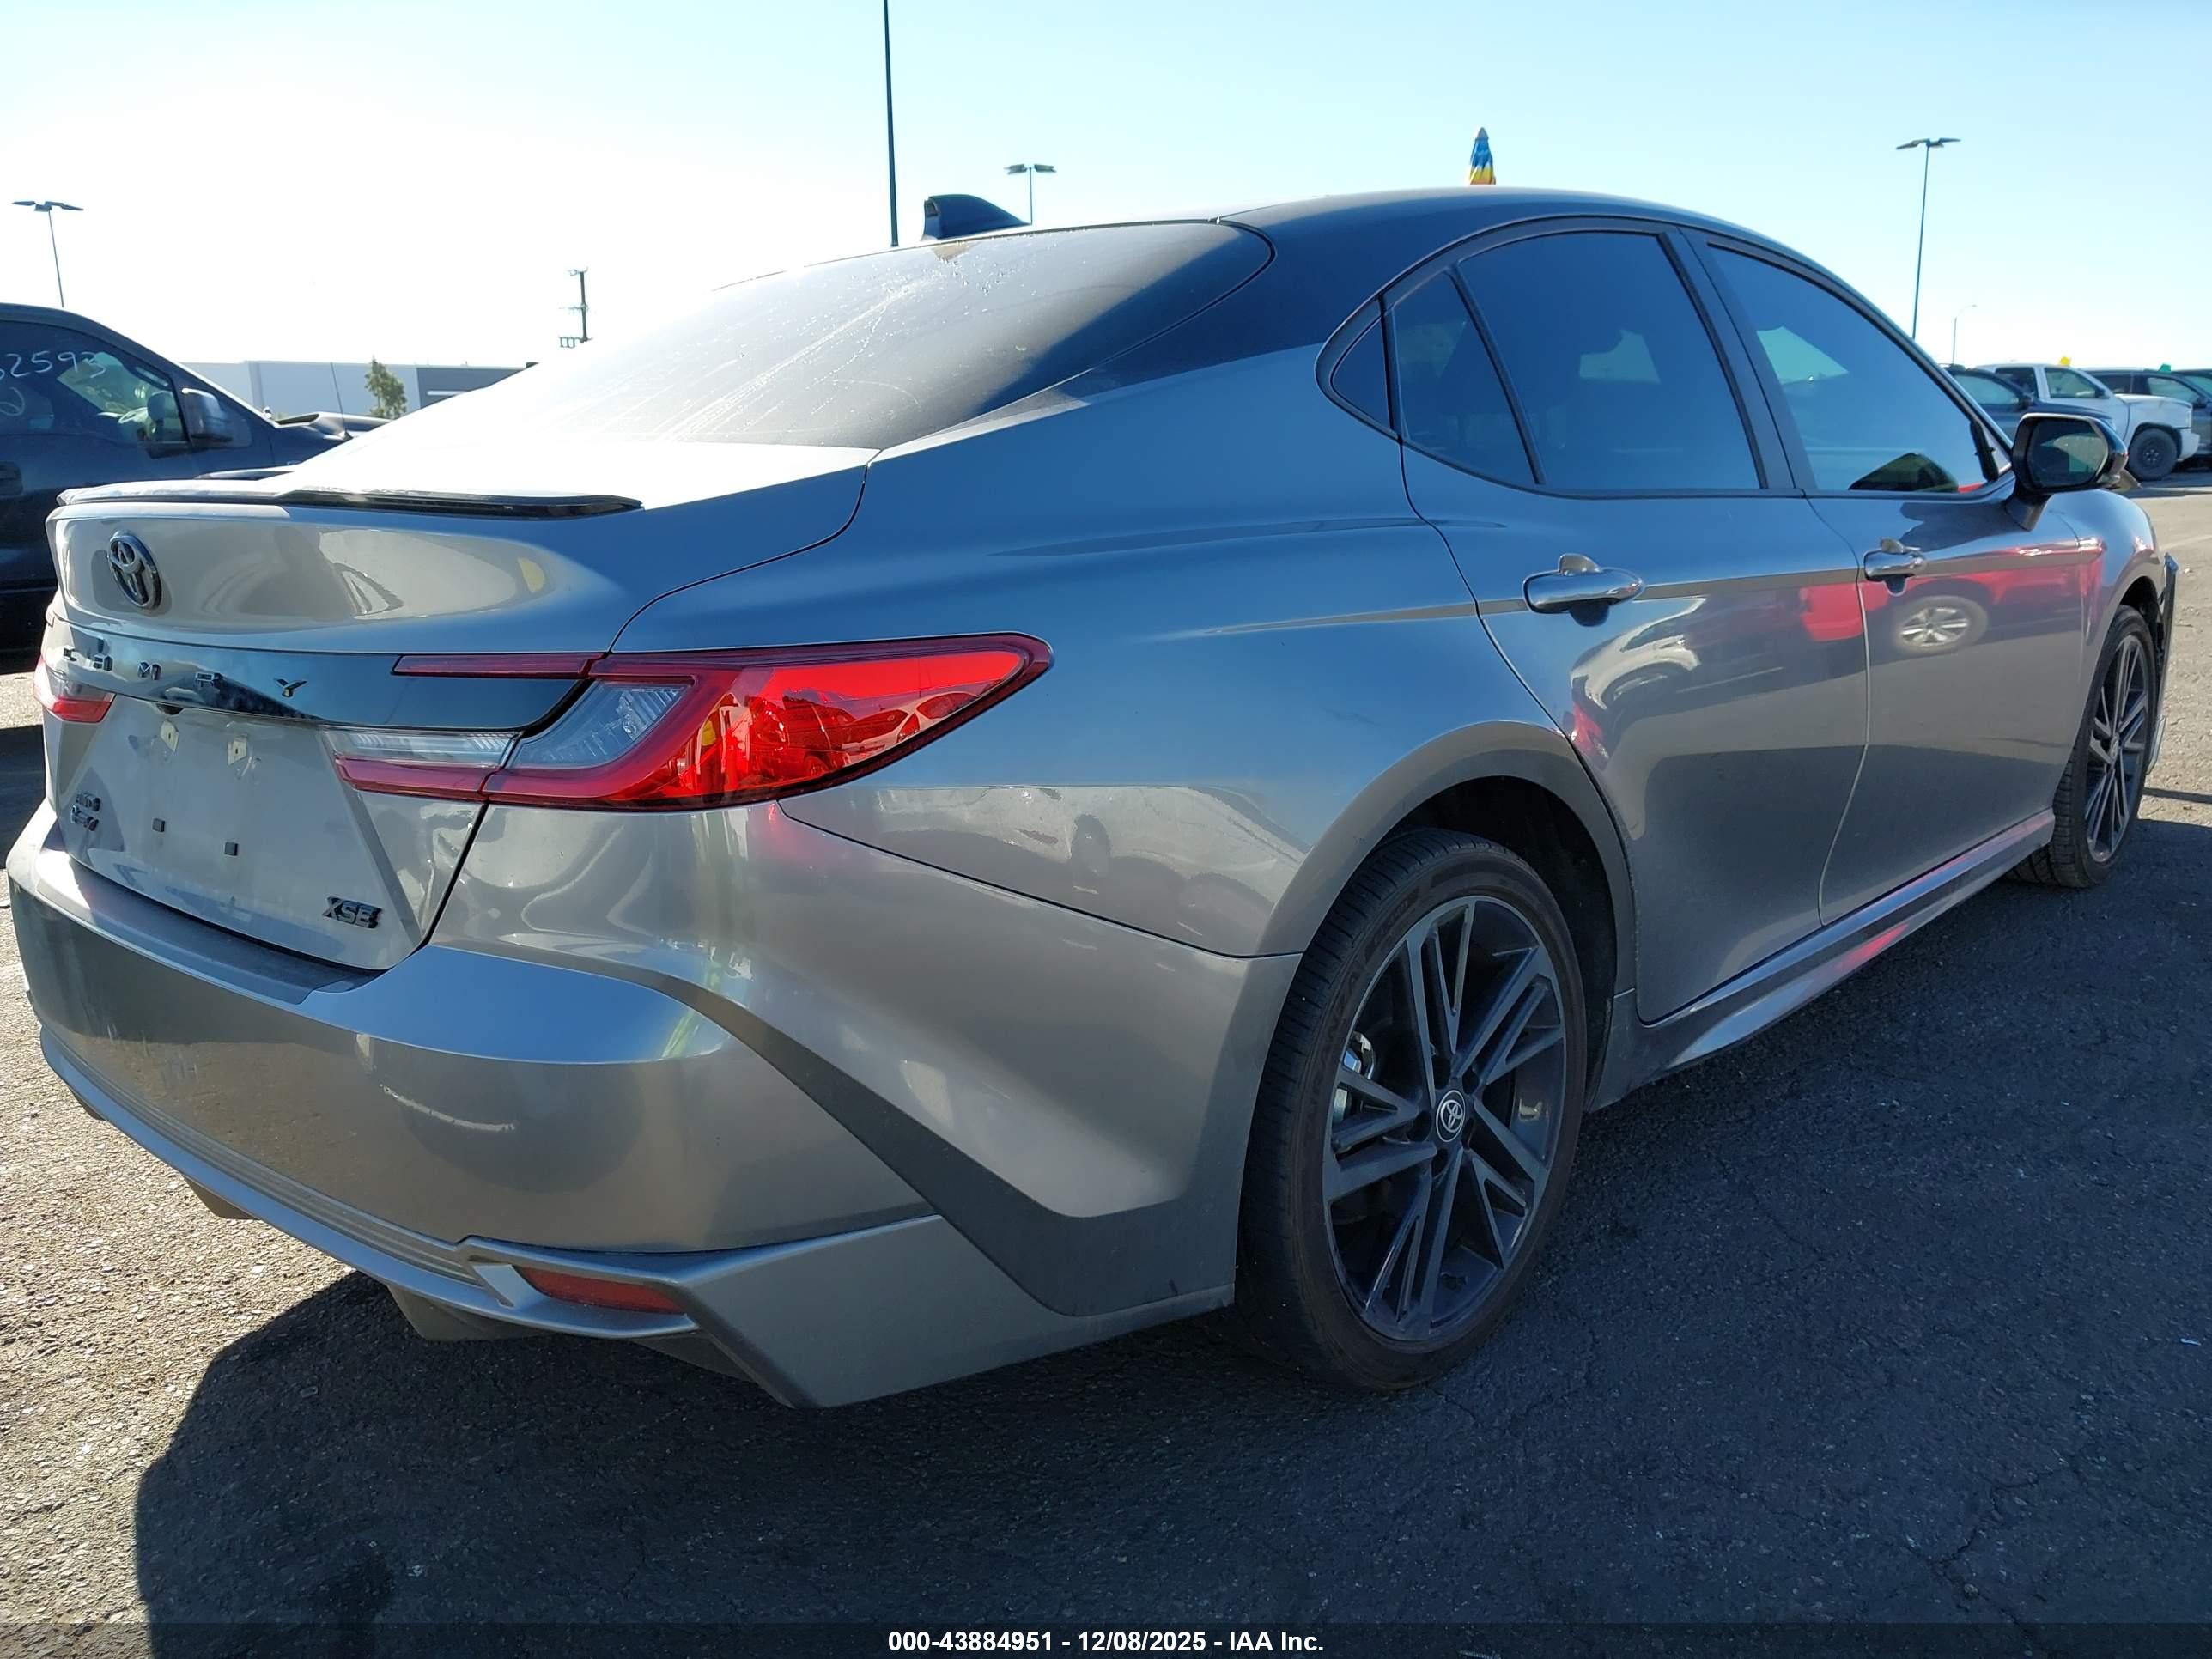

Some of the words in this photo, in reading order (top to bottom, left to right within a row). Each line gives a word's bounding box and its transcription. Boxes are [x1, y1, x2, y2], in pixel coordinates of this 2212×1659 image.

[0, 349, 106, 381] 2593
[63, 645, 308, 698] CAMRY
[322, 896, 382, 929] XSE
